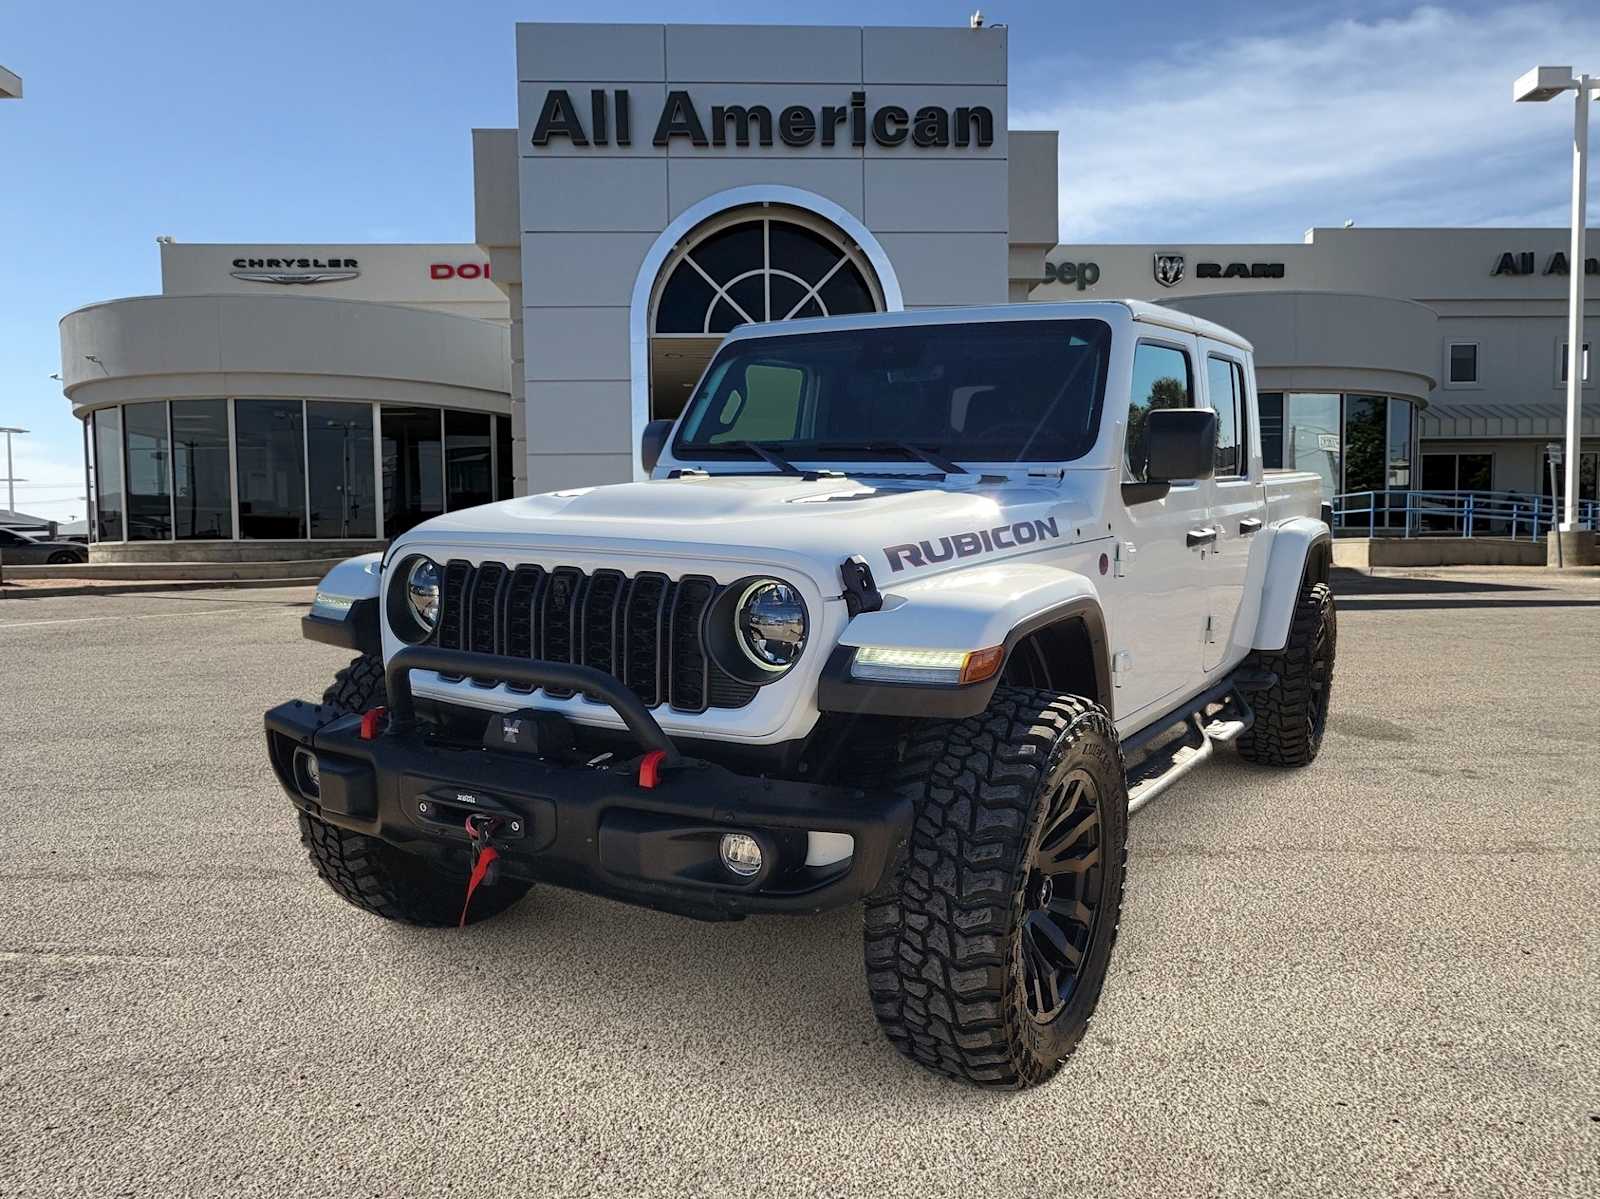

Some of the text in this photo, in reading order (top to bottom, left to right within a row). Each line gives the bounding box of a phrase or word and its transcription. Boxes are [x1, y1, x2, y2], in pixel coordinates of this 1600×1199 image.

[532, 89, 995, 147] All American
[232, 258, 359, 269] CHRYSLER
[430, 263, 490, 279] DO
[1196, 263, 1285, 279] RAM
[1488, 251, 1535, 276] All
[883, 516, 1060, 573] RUBICON
